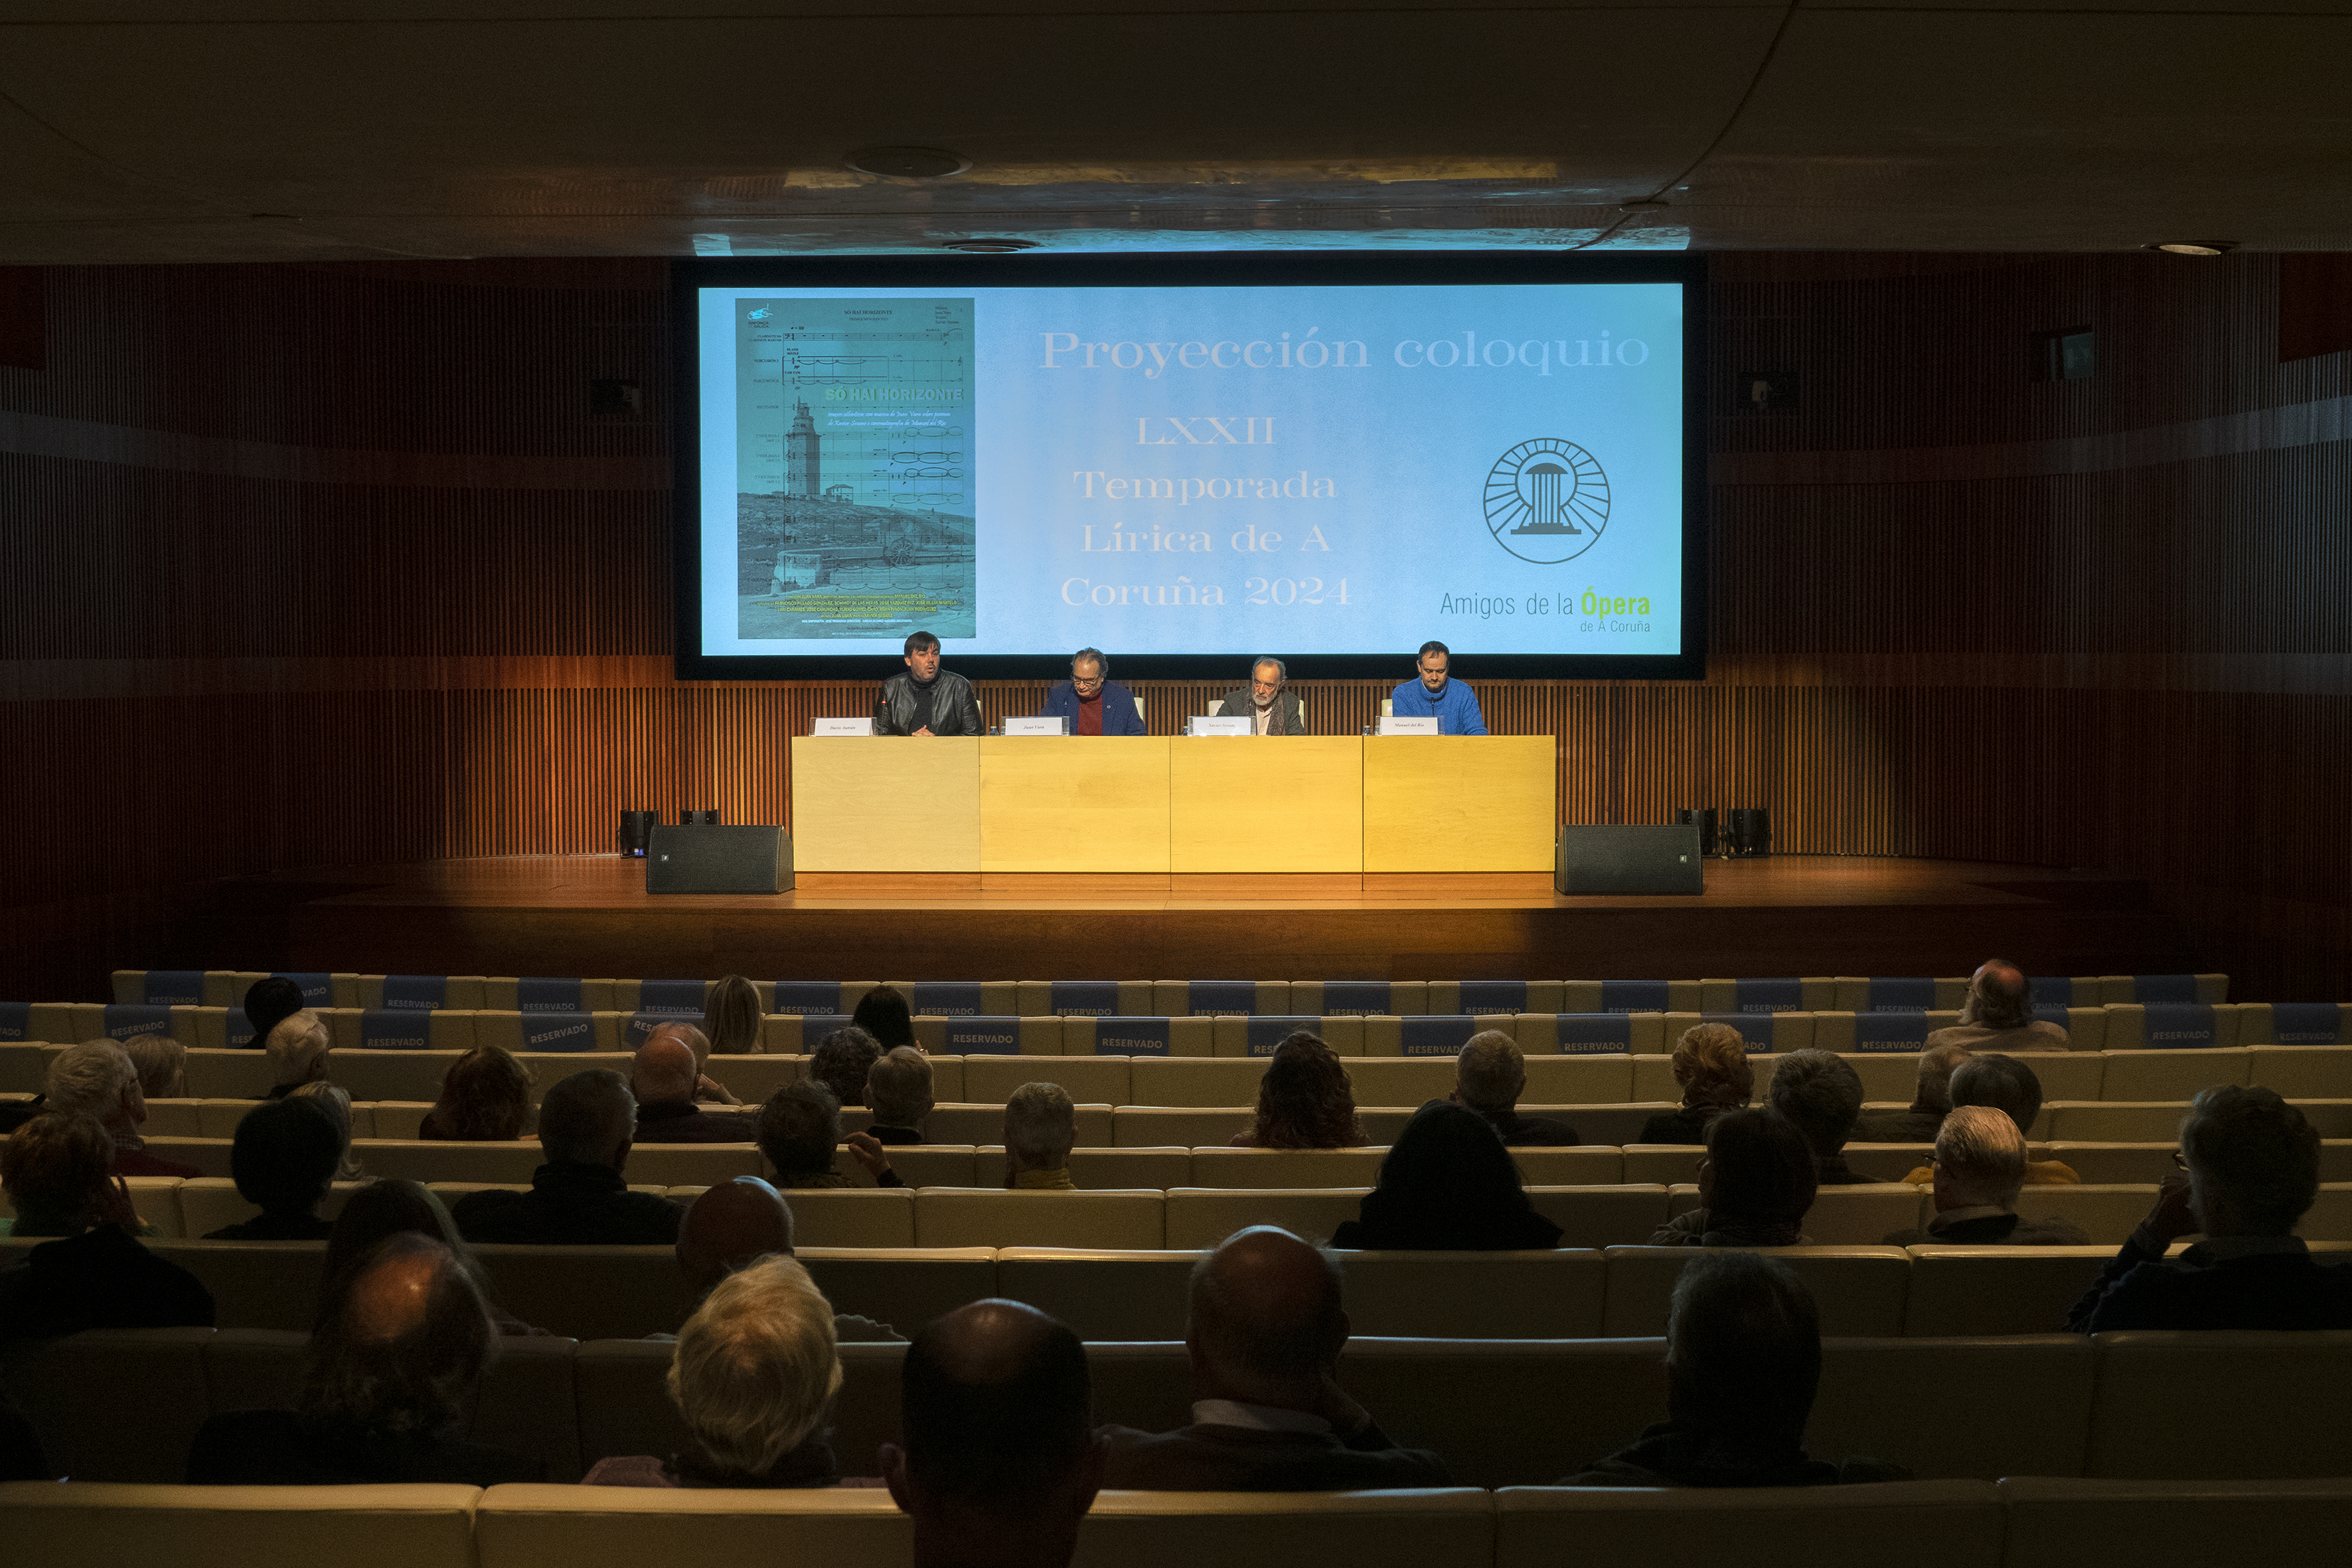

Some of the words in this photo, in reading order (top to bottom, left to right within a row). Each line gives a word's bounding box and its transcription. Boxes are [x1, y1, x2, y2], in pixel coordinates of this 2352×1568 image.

[1039, 325, 1372, 379] Proyección
[1394, 329, 1649, 376] coloquio
[825, 386, 846, 400] SÓ
[850, 389, 876, 400] HAI
[880, 388, 963, 400] HORIZONTE
[1135, 417, 1276, 444] LXXII
[1073, 471, 1338, 506] Temporada
[1081, 522, 1214, 552] Lírica
[1231, 524, 1283, 552] de
[1298, 524, 1332, 552] A
[1061, 576, 1227, 605] Coruña
[1245, 577, 1352, 605] 2024
[1441, 593, 1515, 619] Amigos
[1528, 593, 1549, 615] de
[1558, 593, 1573, 615] la
[1581, 586, 1650, 620] Ópera
[1581, 621, 1593, 631] de
[1599, 621, 1606, 631] A
[1610, 620, 1650, 632] Coruña
[388, 1000, 439, 1009] RESERVADO
[112, 1022, 165, 1036] RESERVADO
[530, 1024, 588, 1044] RESERVADO
[2153, 1031, 2209, 1040] RESERVADO
[368, 1038, 424, 1047] RESERVADO
[953, 1034, 1013, 1044] RESERVADO
[1102, 1038, 1162, 1049] RESERVADO
[1862, 1041, 1921, 1050] RESERVADO
[1565, 1042, 1624, 1052] RESERVADO
